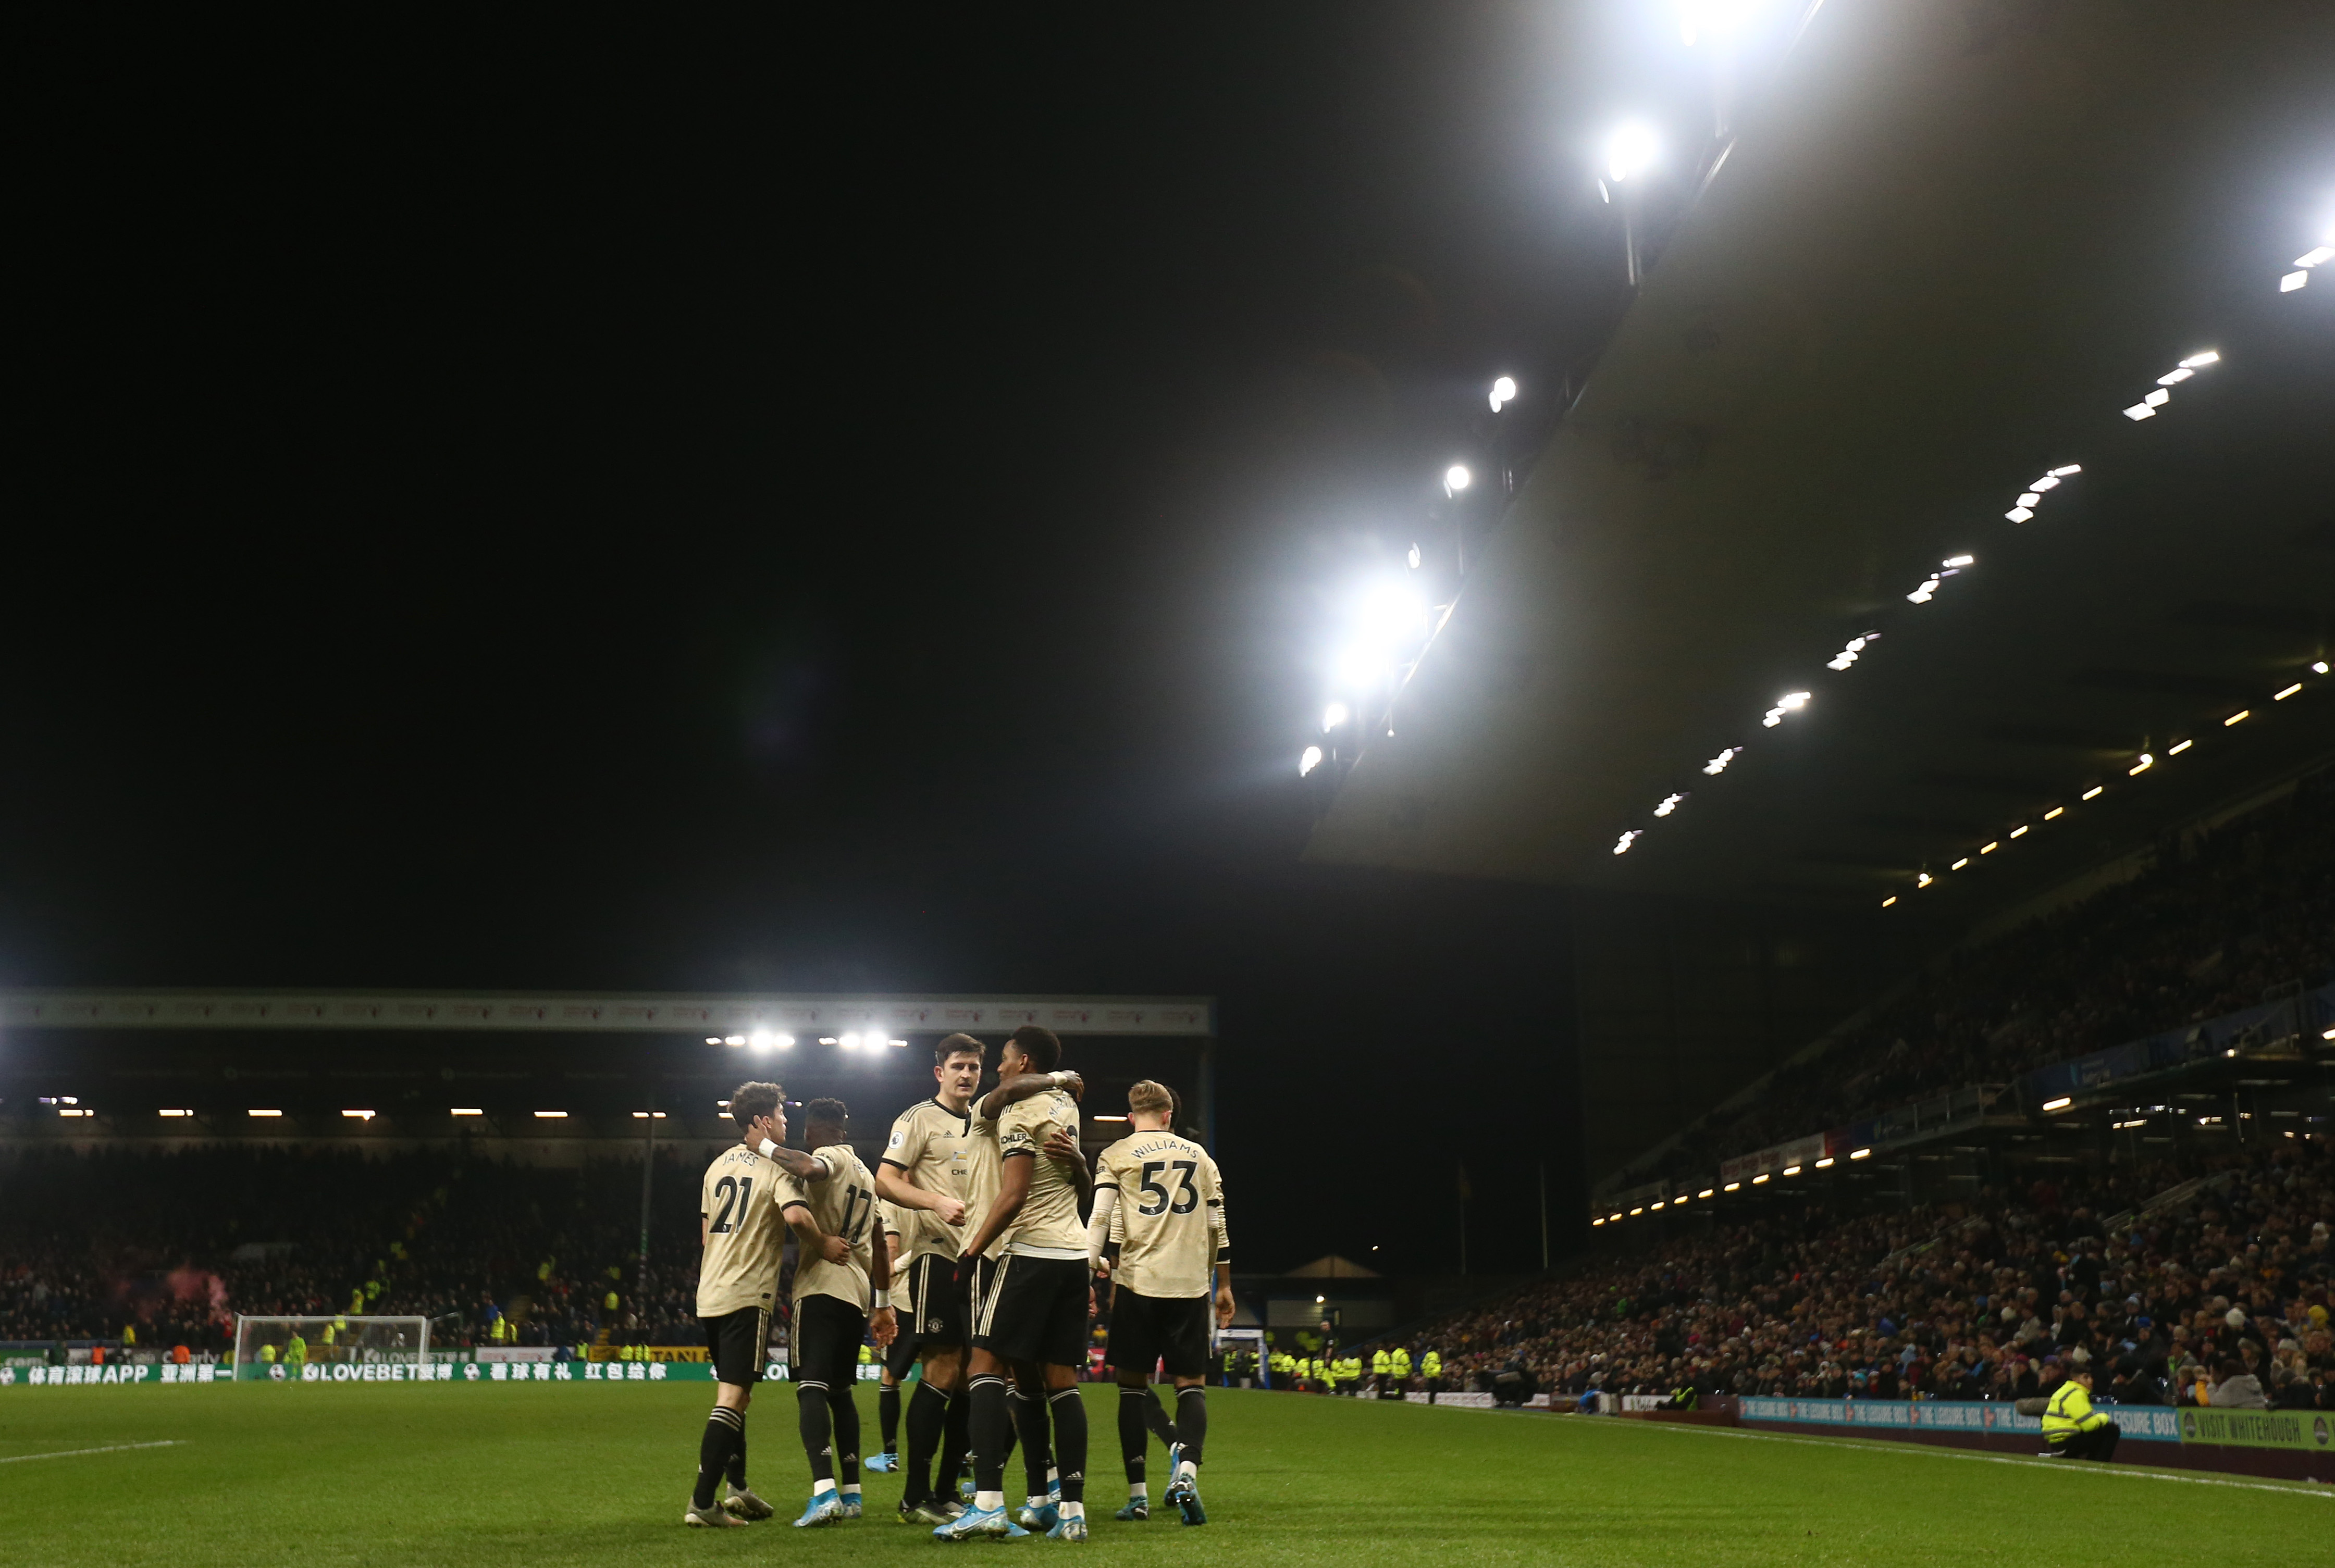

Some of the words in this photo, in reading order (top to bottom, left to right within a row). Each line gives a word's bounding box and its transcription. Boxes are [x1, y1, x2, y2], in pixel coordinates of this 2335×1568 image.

[723, 1152, 758, 1166] JAMES
[1131, 1140, 1199, 1159] WILLIAMS
[709, 1176, 753, 1234] 21
[1139, 1160, 1199, 1216] 53
[839, 1183, 873, 1244] 17
[2197, 1413, 2226, 1438] VISIT
